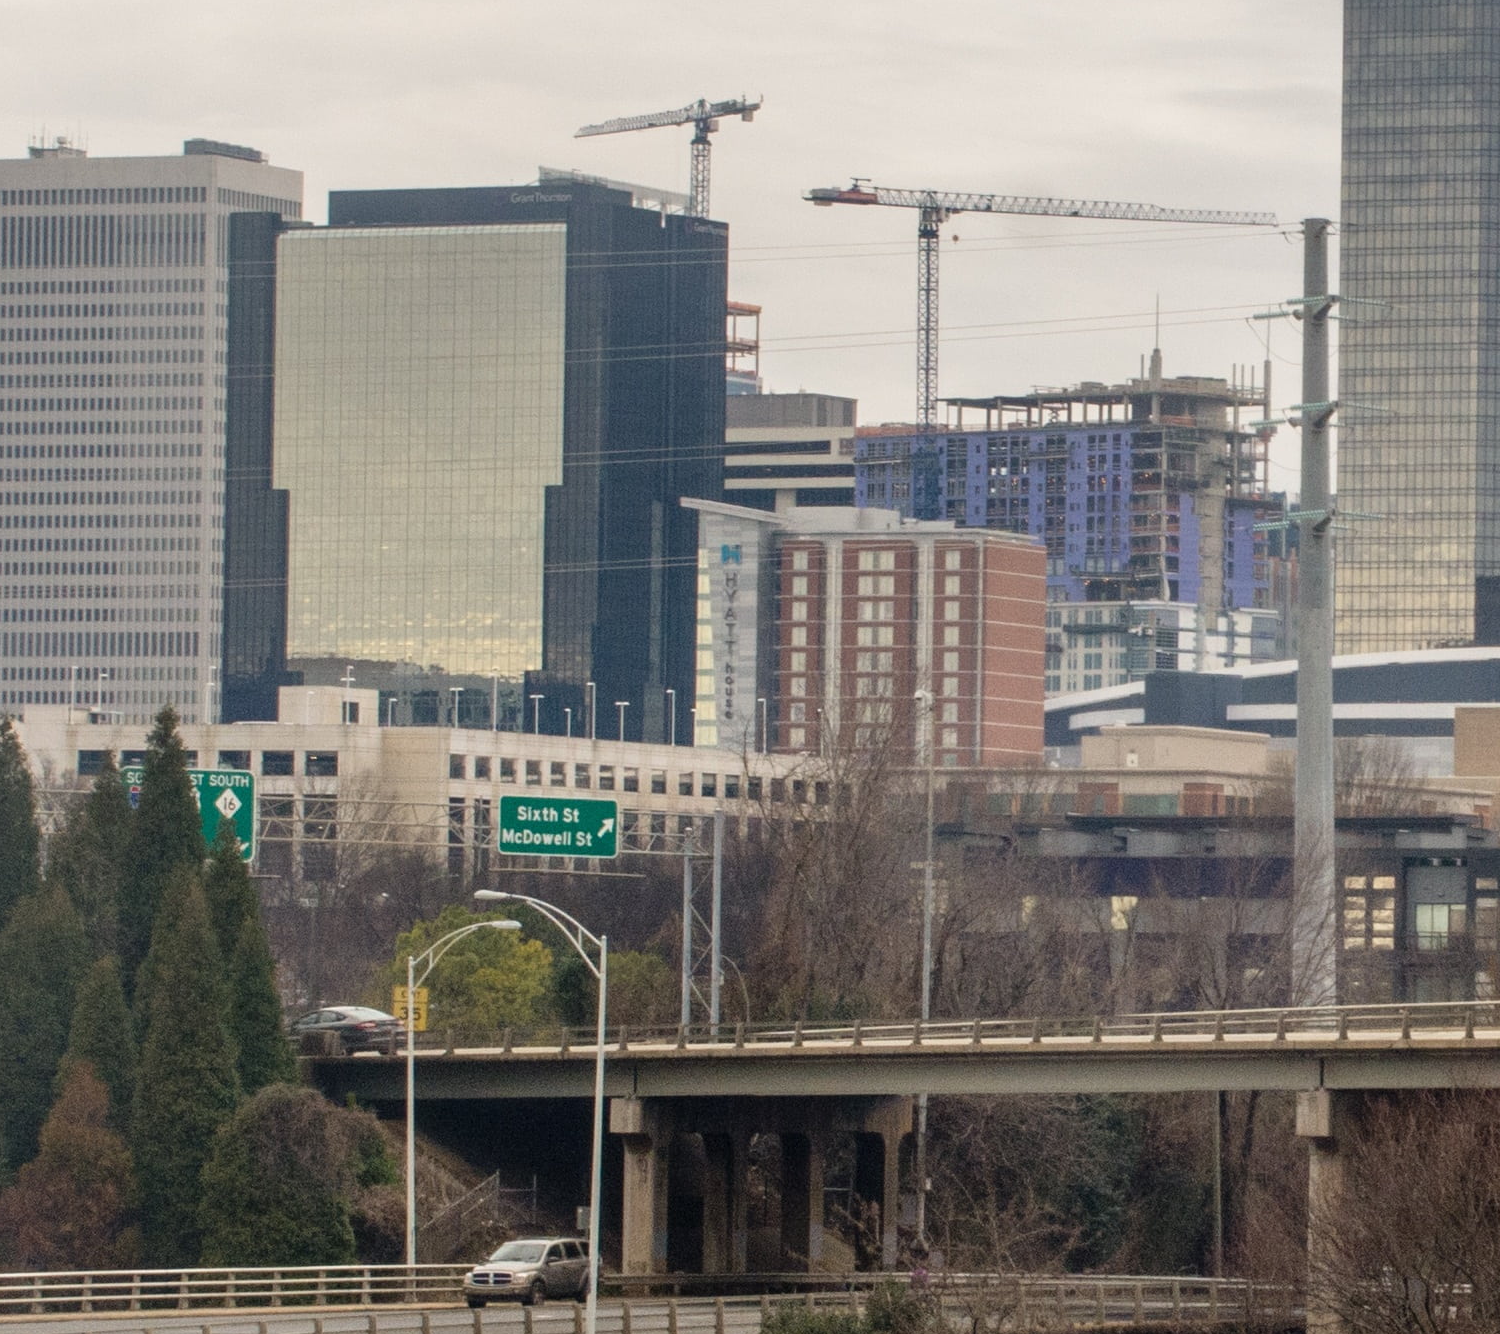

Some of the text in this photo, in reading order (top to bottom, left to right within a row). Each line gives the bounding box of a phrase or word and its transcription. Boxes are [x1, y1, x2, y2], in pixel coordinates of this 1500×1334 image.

[725, 572, 738, 657] HYATT
[189, 774, 250, 788] ST SOUTH
[223, 797, 237, 811] 16
[517, 805, 580, 824] Sixth St
[502, 828, 593, 848] McDowell St
[399, 1006, 422, 1021] 35
